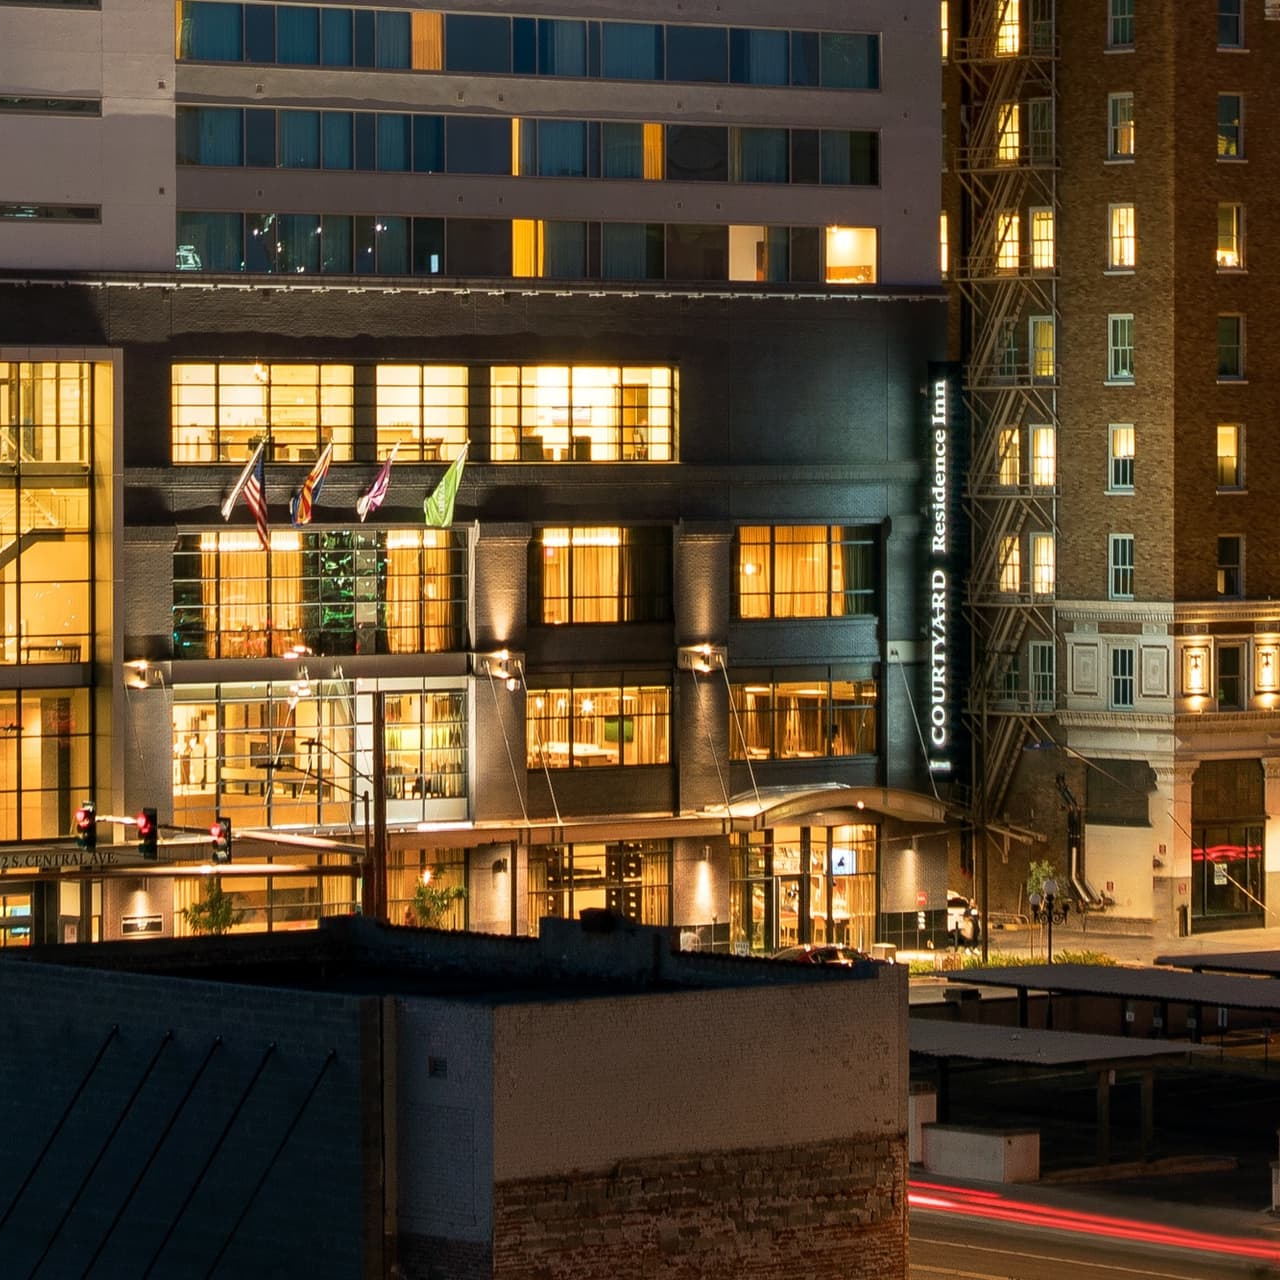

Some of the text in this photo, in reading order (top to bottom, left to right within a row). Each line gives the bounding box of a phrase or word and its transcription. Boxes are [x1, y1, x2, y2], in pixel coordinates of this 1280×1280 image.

[932, 379, 946, 425] Inn
[932, 428, 946, 553] Residence
[931, 569, 946, 746] COURTYARD
[11, 855, 22, 868] S.
[25, 853, 87, 867] CENTRAL
[89, 852, 119, 865] AVE.
